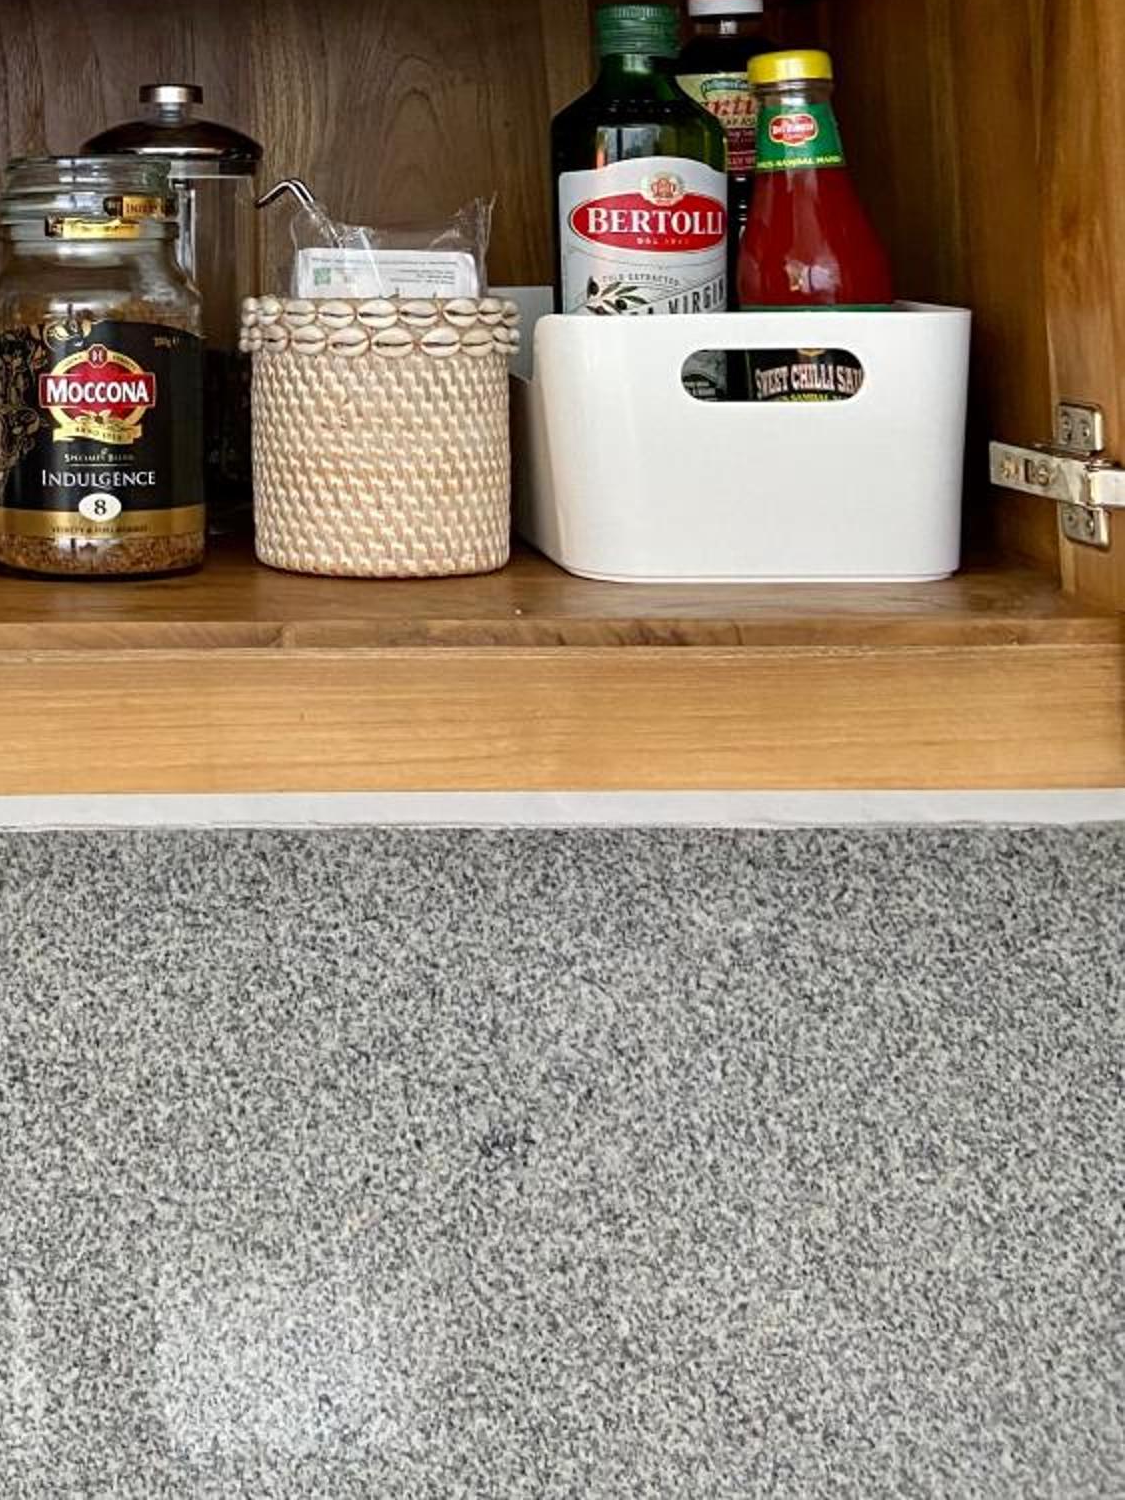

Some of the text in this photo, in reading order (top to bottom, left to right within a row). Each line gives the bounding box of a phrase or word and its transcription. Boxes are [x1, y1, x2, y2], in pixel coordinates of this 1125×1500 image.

[587, 207, 723, 235] BERTOLLI
[668, 277, 725, 314] VIRGIN
[791, 363, 836, 392] CHILLI
[42, 469, 156, 491] INDULGENCE
[94, 499, 107, 516] 8
